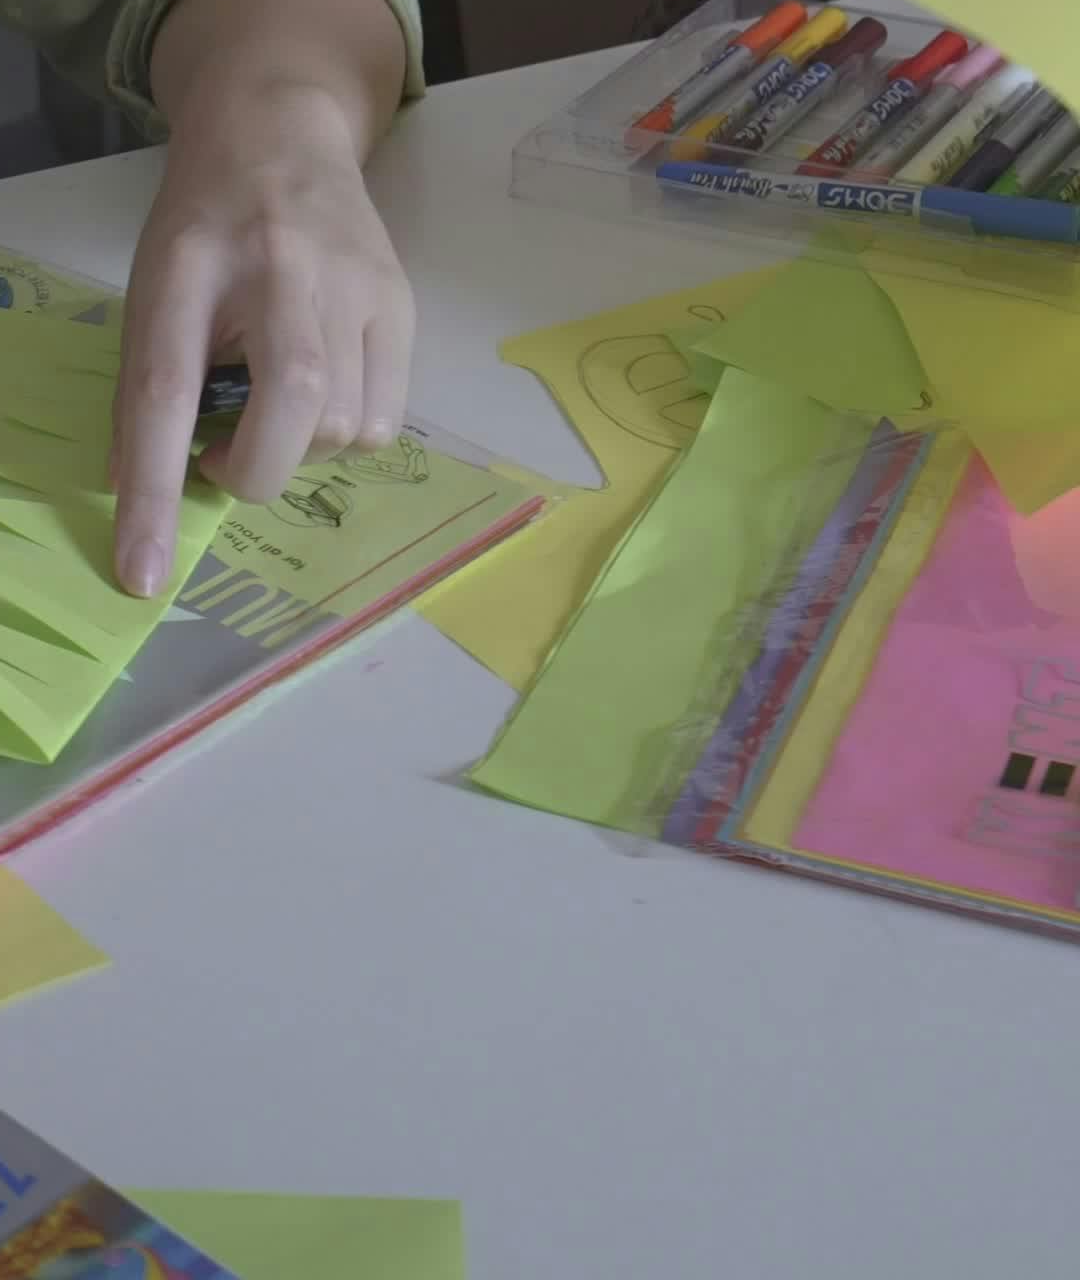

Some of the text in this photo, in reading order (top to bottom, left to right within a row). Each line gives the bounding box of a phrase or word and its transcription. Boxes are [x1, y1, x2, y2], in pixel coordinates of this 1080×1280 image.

[823, 188, 909, 214] DOMS
[223, 530, 250, 555] The
[224, 519, 306, 572] for all your
[178, 553, 326, 649] MUL
